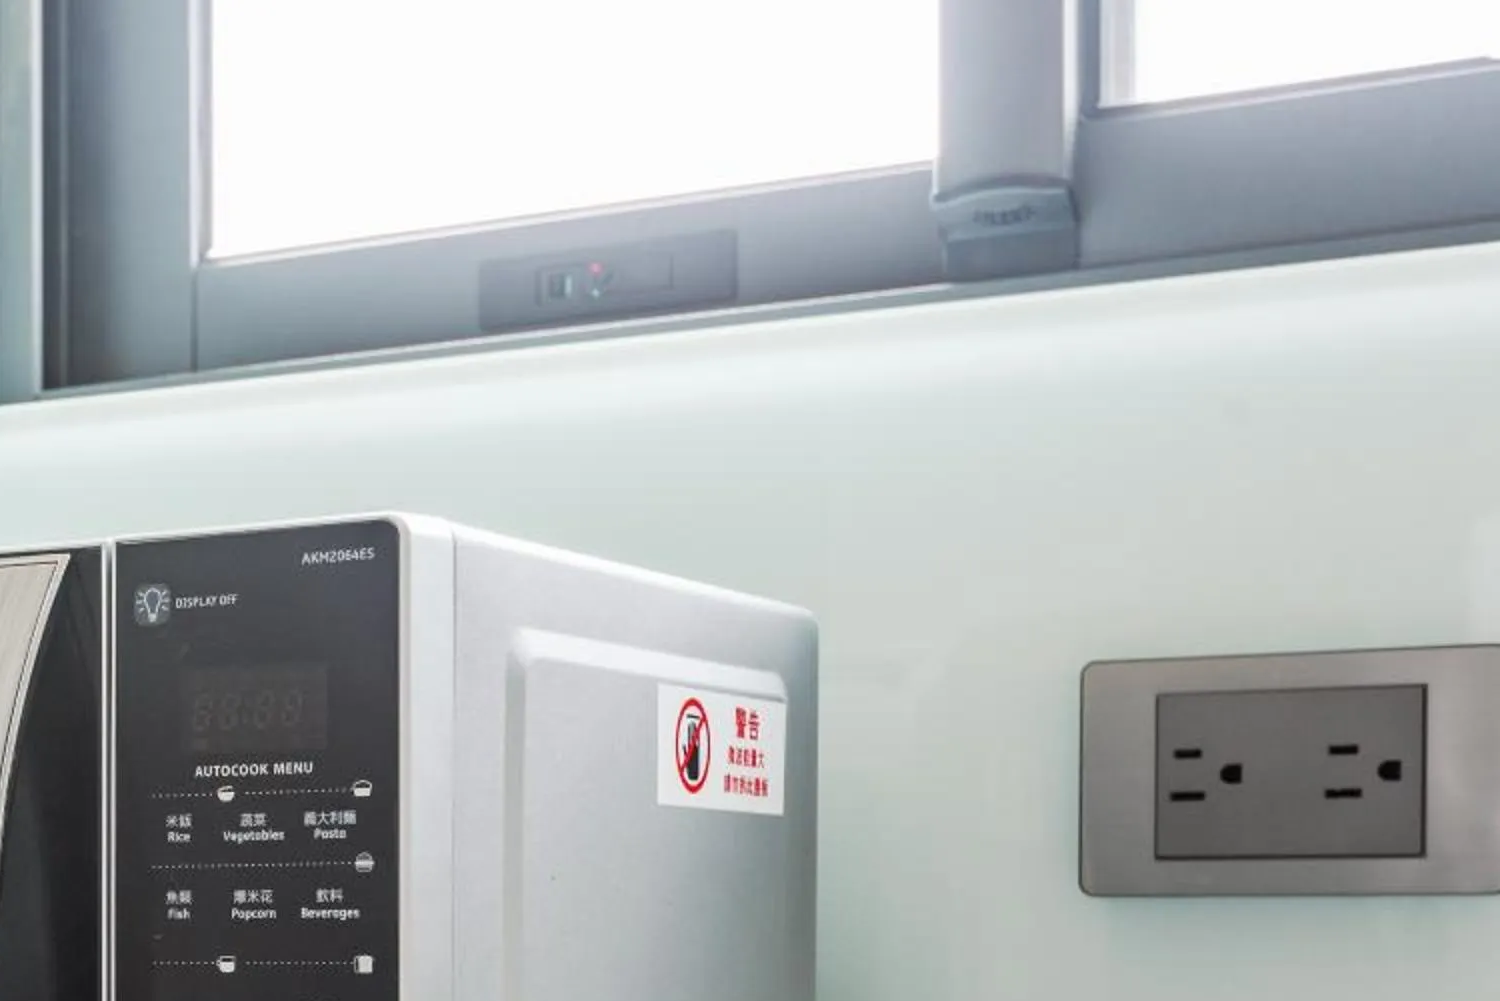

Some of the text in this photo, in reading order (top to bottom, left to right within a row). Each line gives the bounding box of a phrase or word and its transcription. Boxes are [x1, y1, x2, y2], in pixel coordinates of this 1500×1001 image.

[176, 594, 238, 608] DISPLAY OFF
[735, 707, 759, 740] 警告
[195, 762, 313, 778] AUTOCOOK MENU
[168, 831, 190, 842] Rice
[224, 830, 284, 844] Vegetables
[314, 828, 347, 840] Pasta
[232, 908, 276, 920] Popcorn
[301, 908, 360, 920] Beverages
